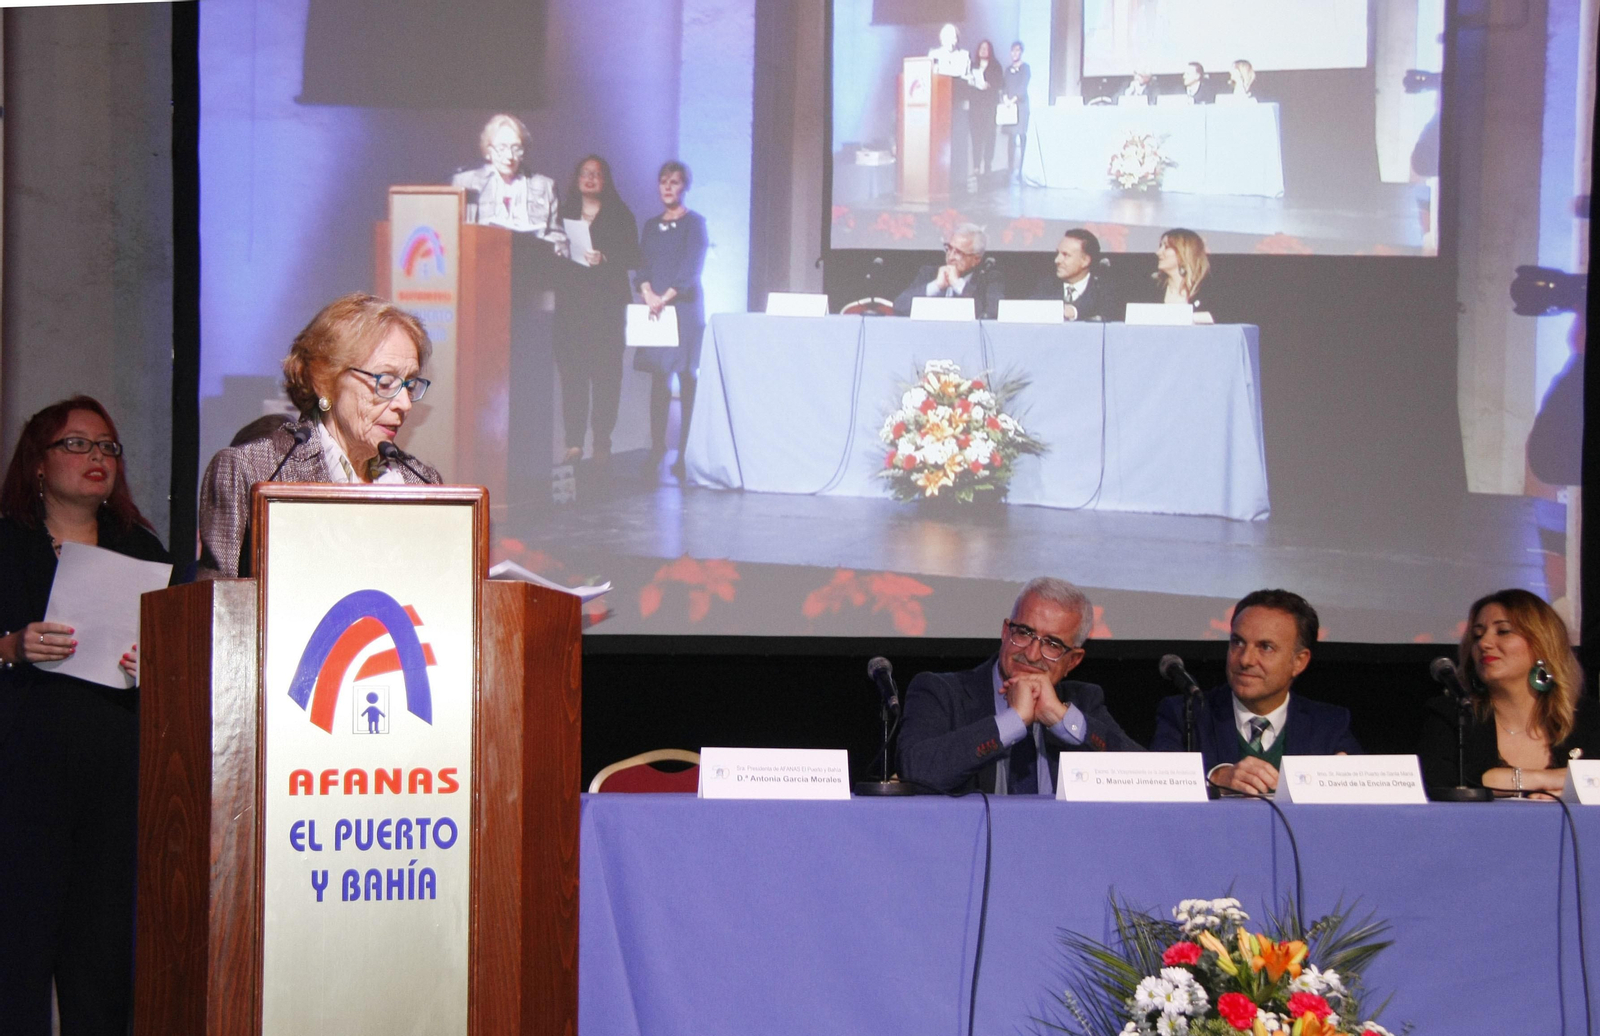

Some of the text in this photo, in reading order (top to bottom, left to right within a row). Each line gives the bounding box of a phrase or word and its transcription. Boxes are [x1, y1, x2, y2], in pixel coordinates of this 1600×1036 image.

[289, 767, 460, 796] AFANAS
[750, 774, 781, 783] Antonia
[810, 775, 842, 784] Morales
[1106, 777, 1134, 785] Manuel
[1169, 777, 1198, 786] Barrios
[1327, 779, 1348, 788] David
[1349, 779, 1358, 788] de
[1358, 779, 1366, 788] la
[1366, 779, 1391, 788] Encina
[1391, 779, 1416, 789] Ortega
[289, 816, 459, 852] EL PUERTO
[311, 858, 437, 902] Y BAHÍA
